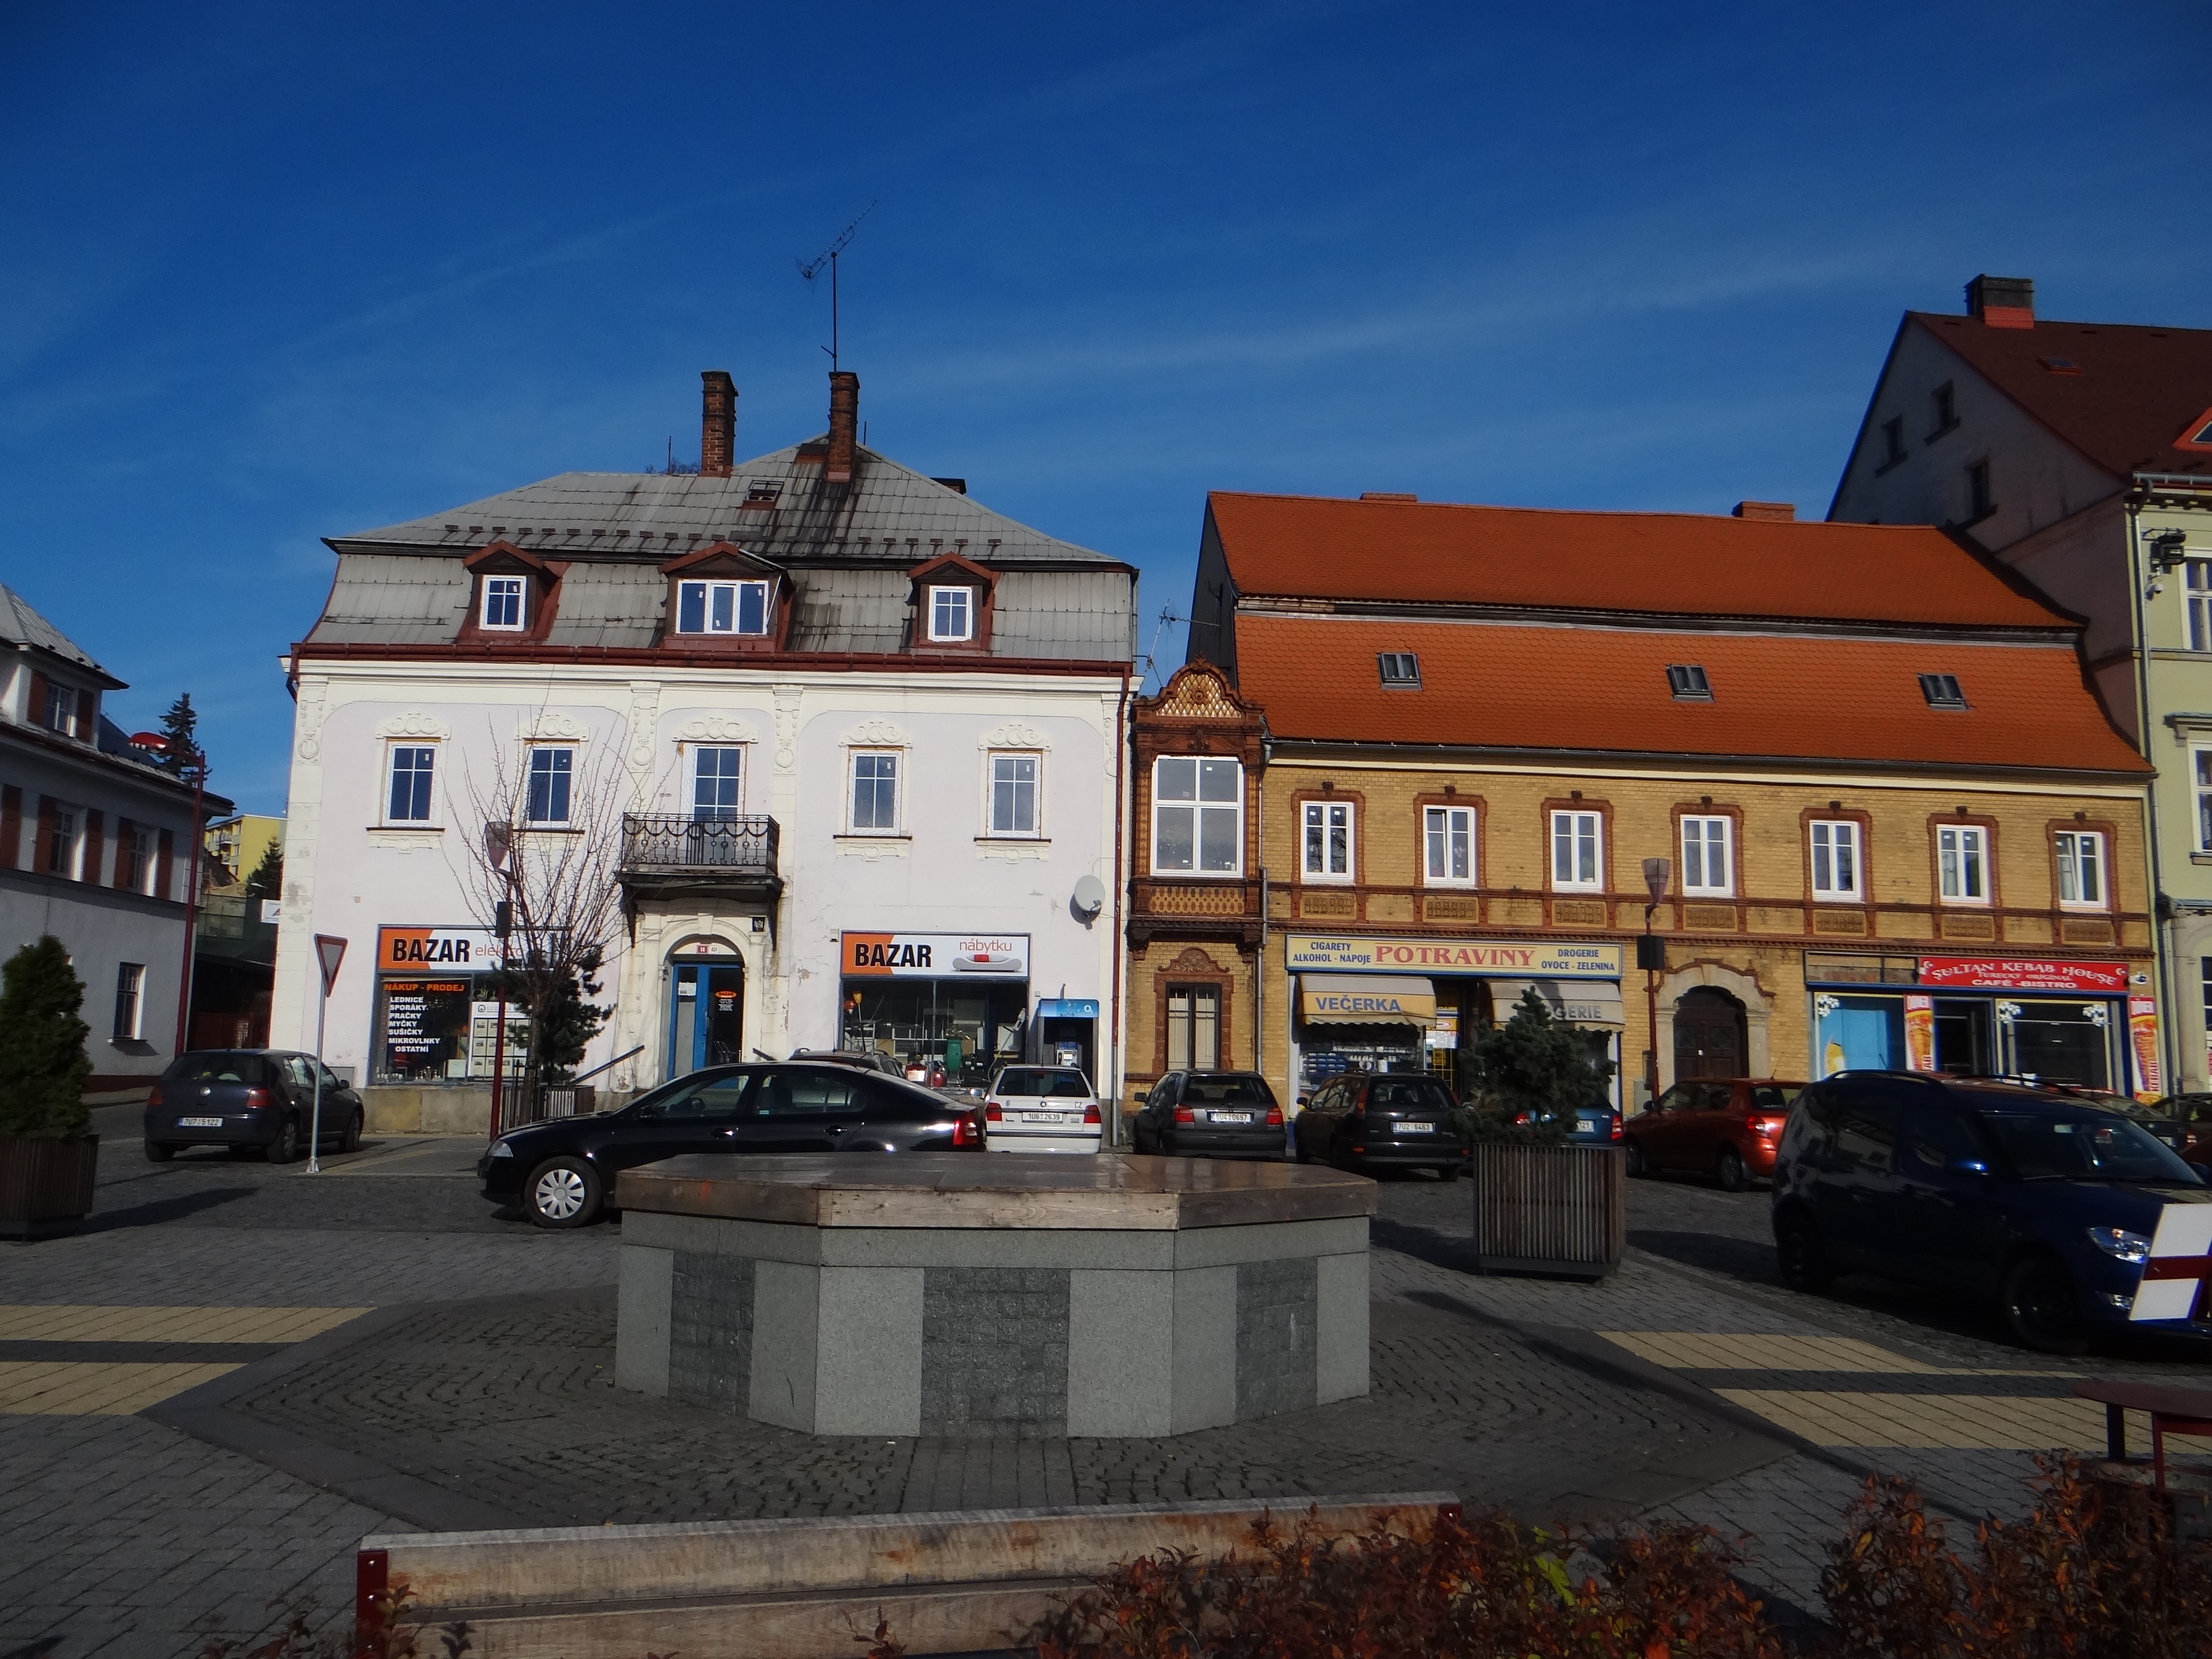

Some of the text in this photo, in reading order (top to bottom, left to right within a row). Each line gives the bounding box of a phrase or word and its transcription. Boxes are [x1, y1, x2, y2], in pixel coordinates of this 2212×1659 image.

[392, 939, 523, 962] BAZAR elekro
[959, 939, 1013, 953] nábytku
[1310, 942, 1352, 951] CIGARETY
[1558, 949, 1599, 957] DROGERIE
[854, 944, 931, 967] BAZAR
[1375, 946, 1537, 966] POTRAVINY
[1541, 960, 1569, 970] OVOCE
[1577, 962, 1615, 970] ZELENINA
[2001, 962, 2056, 973] KEBAB
[2062, 967, 2116, 985] HOUSE
[384, 982, 418, 991] NÁKUP
[1315, 994, 1402, 1012] VEČERKA
